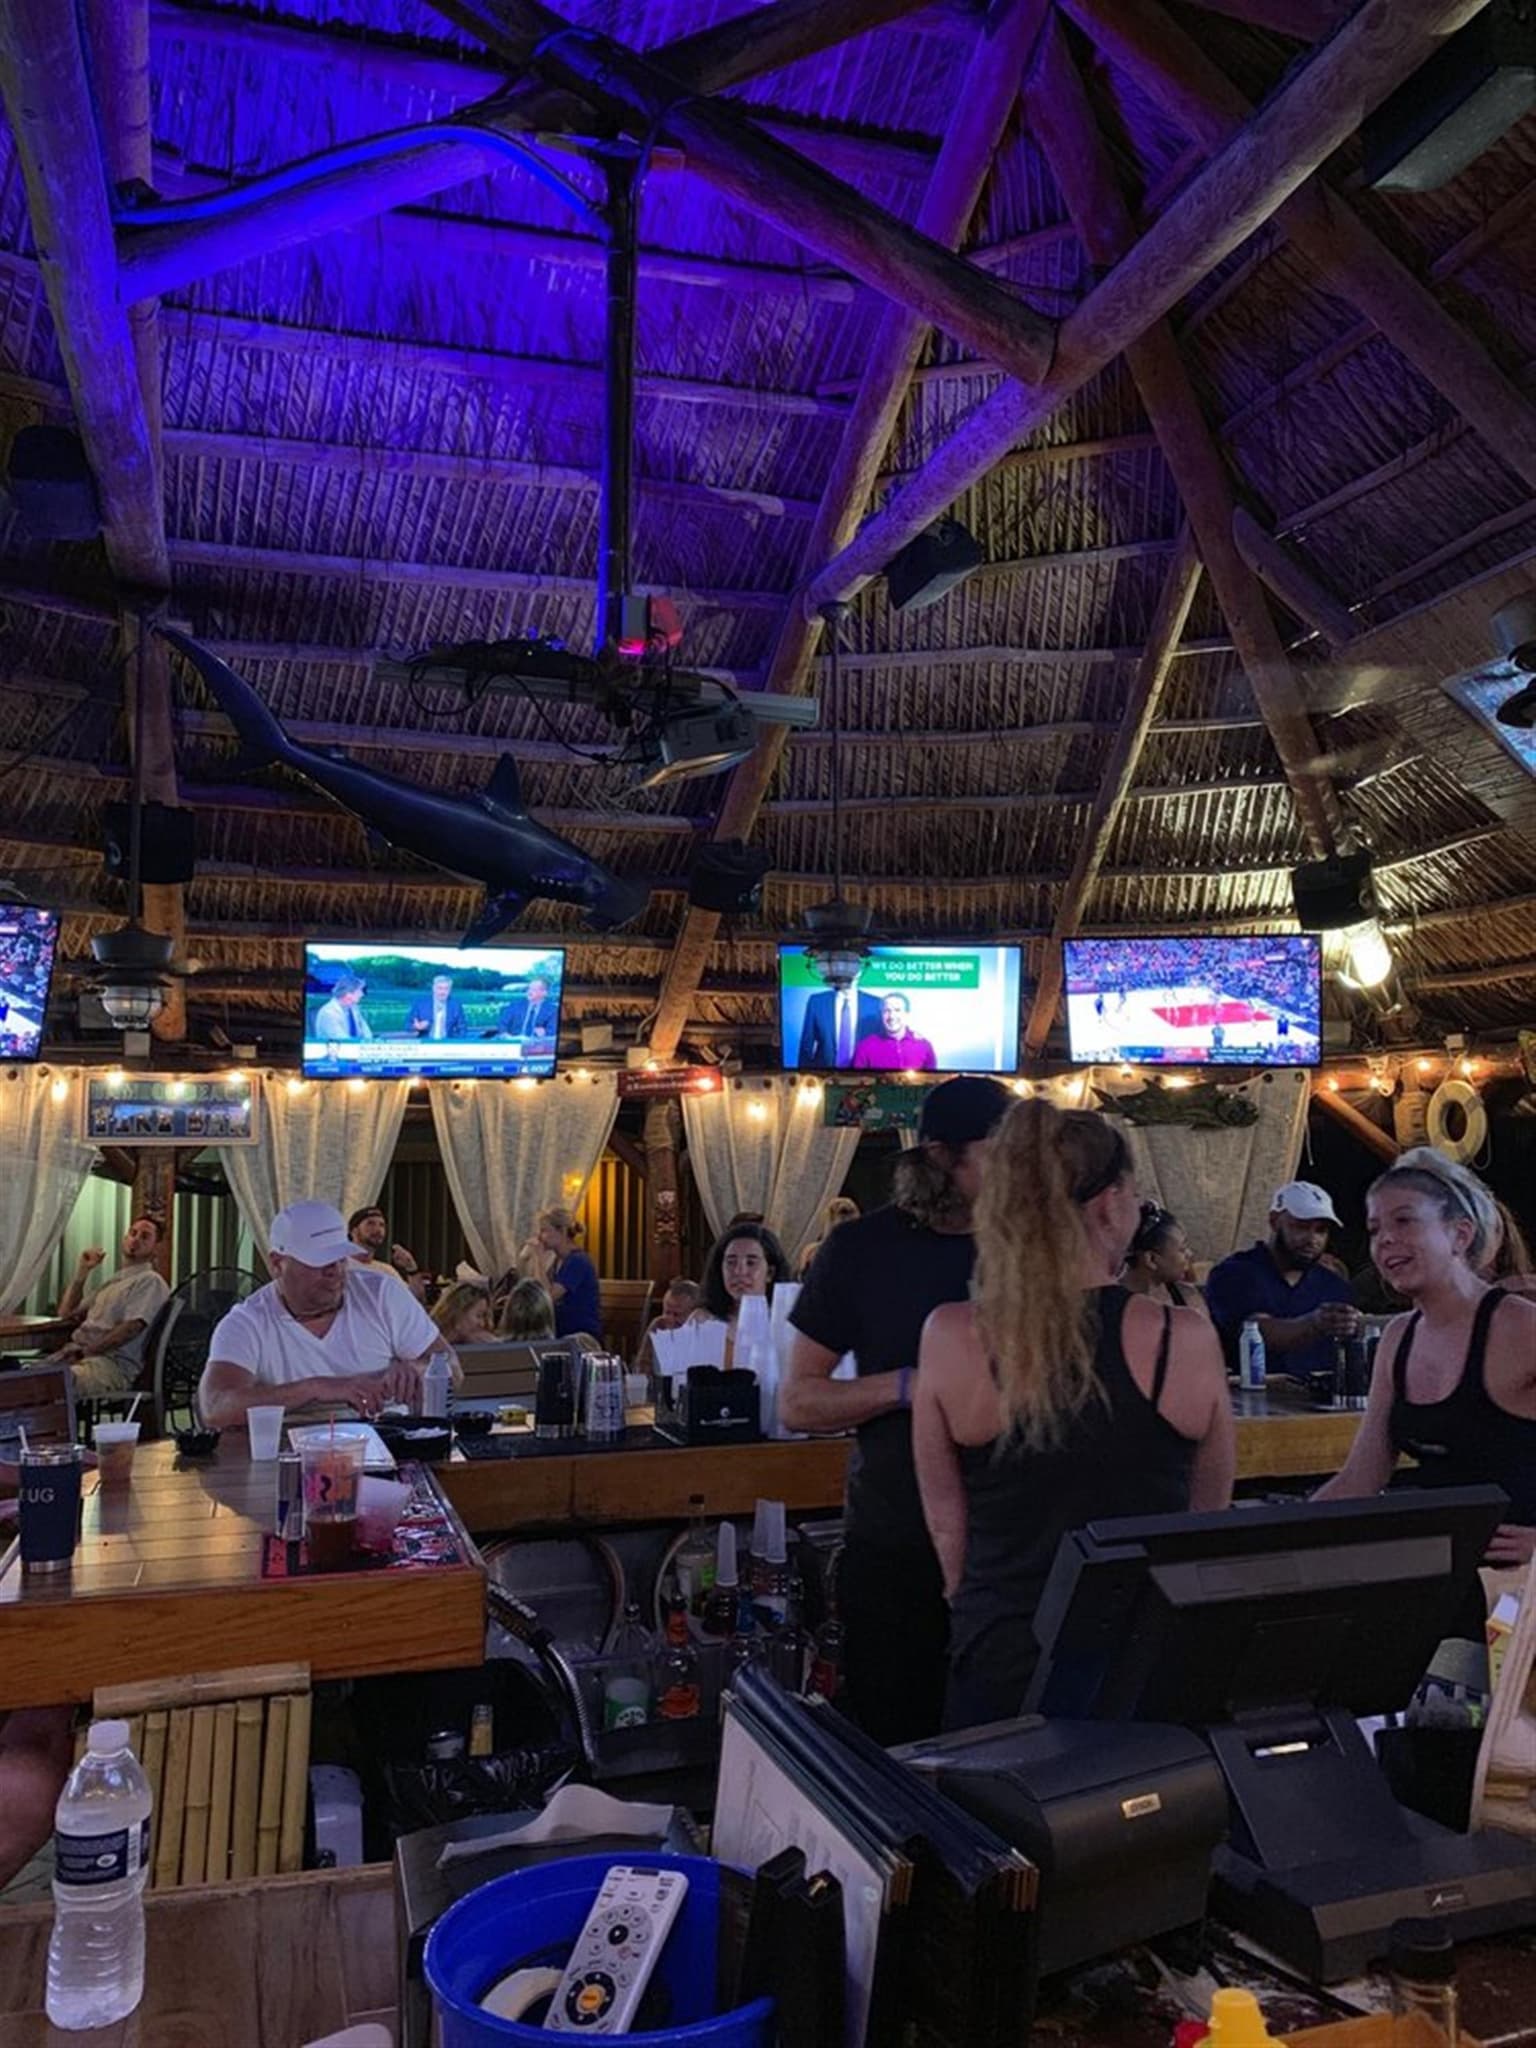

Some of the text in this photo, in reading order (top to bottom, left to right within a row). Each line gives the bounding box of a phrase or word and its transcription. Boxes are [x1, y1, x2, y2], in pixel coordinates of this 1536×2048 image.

[872, 961, 974, 971] WE DO BETTER WHEN
[885, 972, 961, 982] YOU DO BETTER
